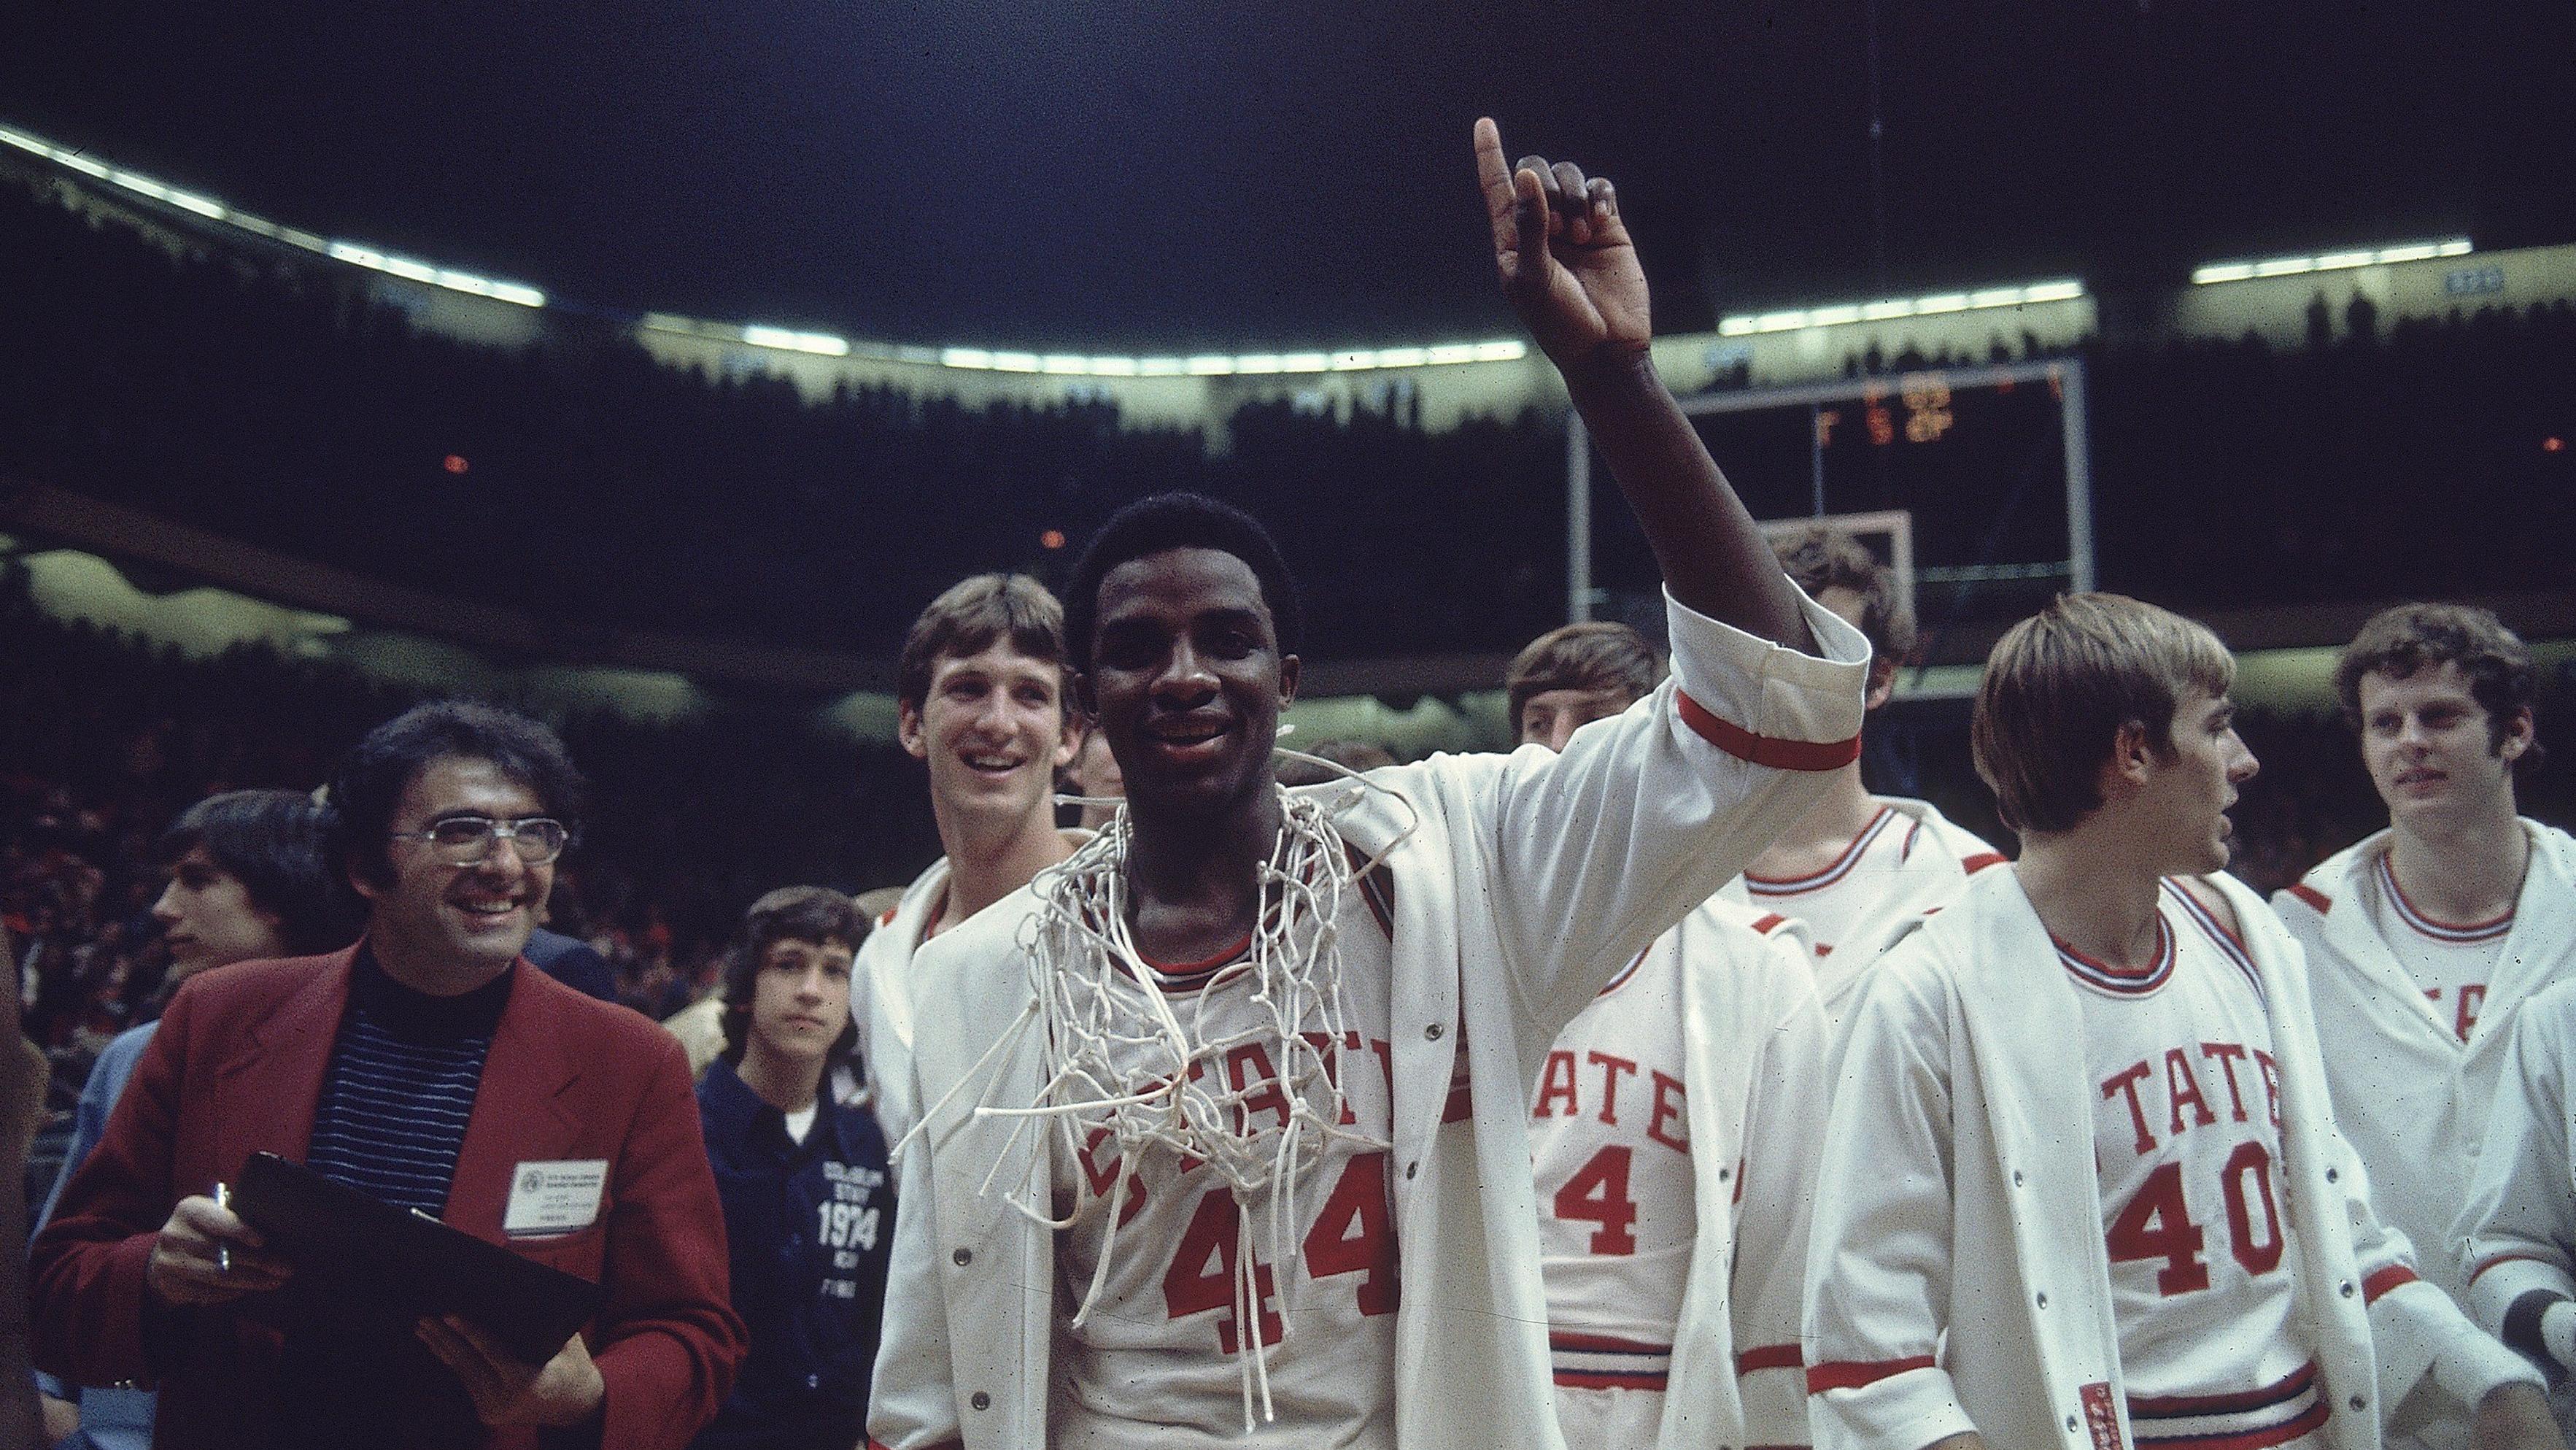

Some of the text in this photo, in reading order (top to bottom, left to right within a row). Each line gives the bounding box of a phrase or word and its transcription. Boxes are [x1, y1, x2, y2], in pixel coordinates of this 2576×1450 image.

[1533, 1050, 1690, 1154] ATE
[817, 1199, 881, 1251] 1974
[1162, 1151, 1402, 1356] 44
[2104, 1140, 2285, 1297] 40
